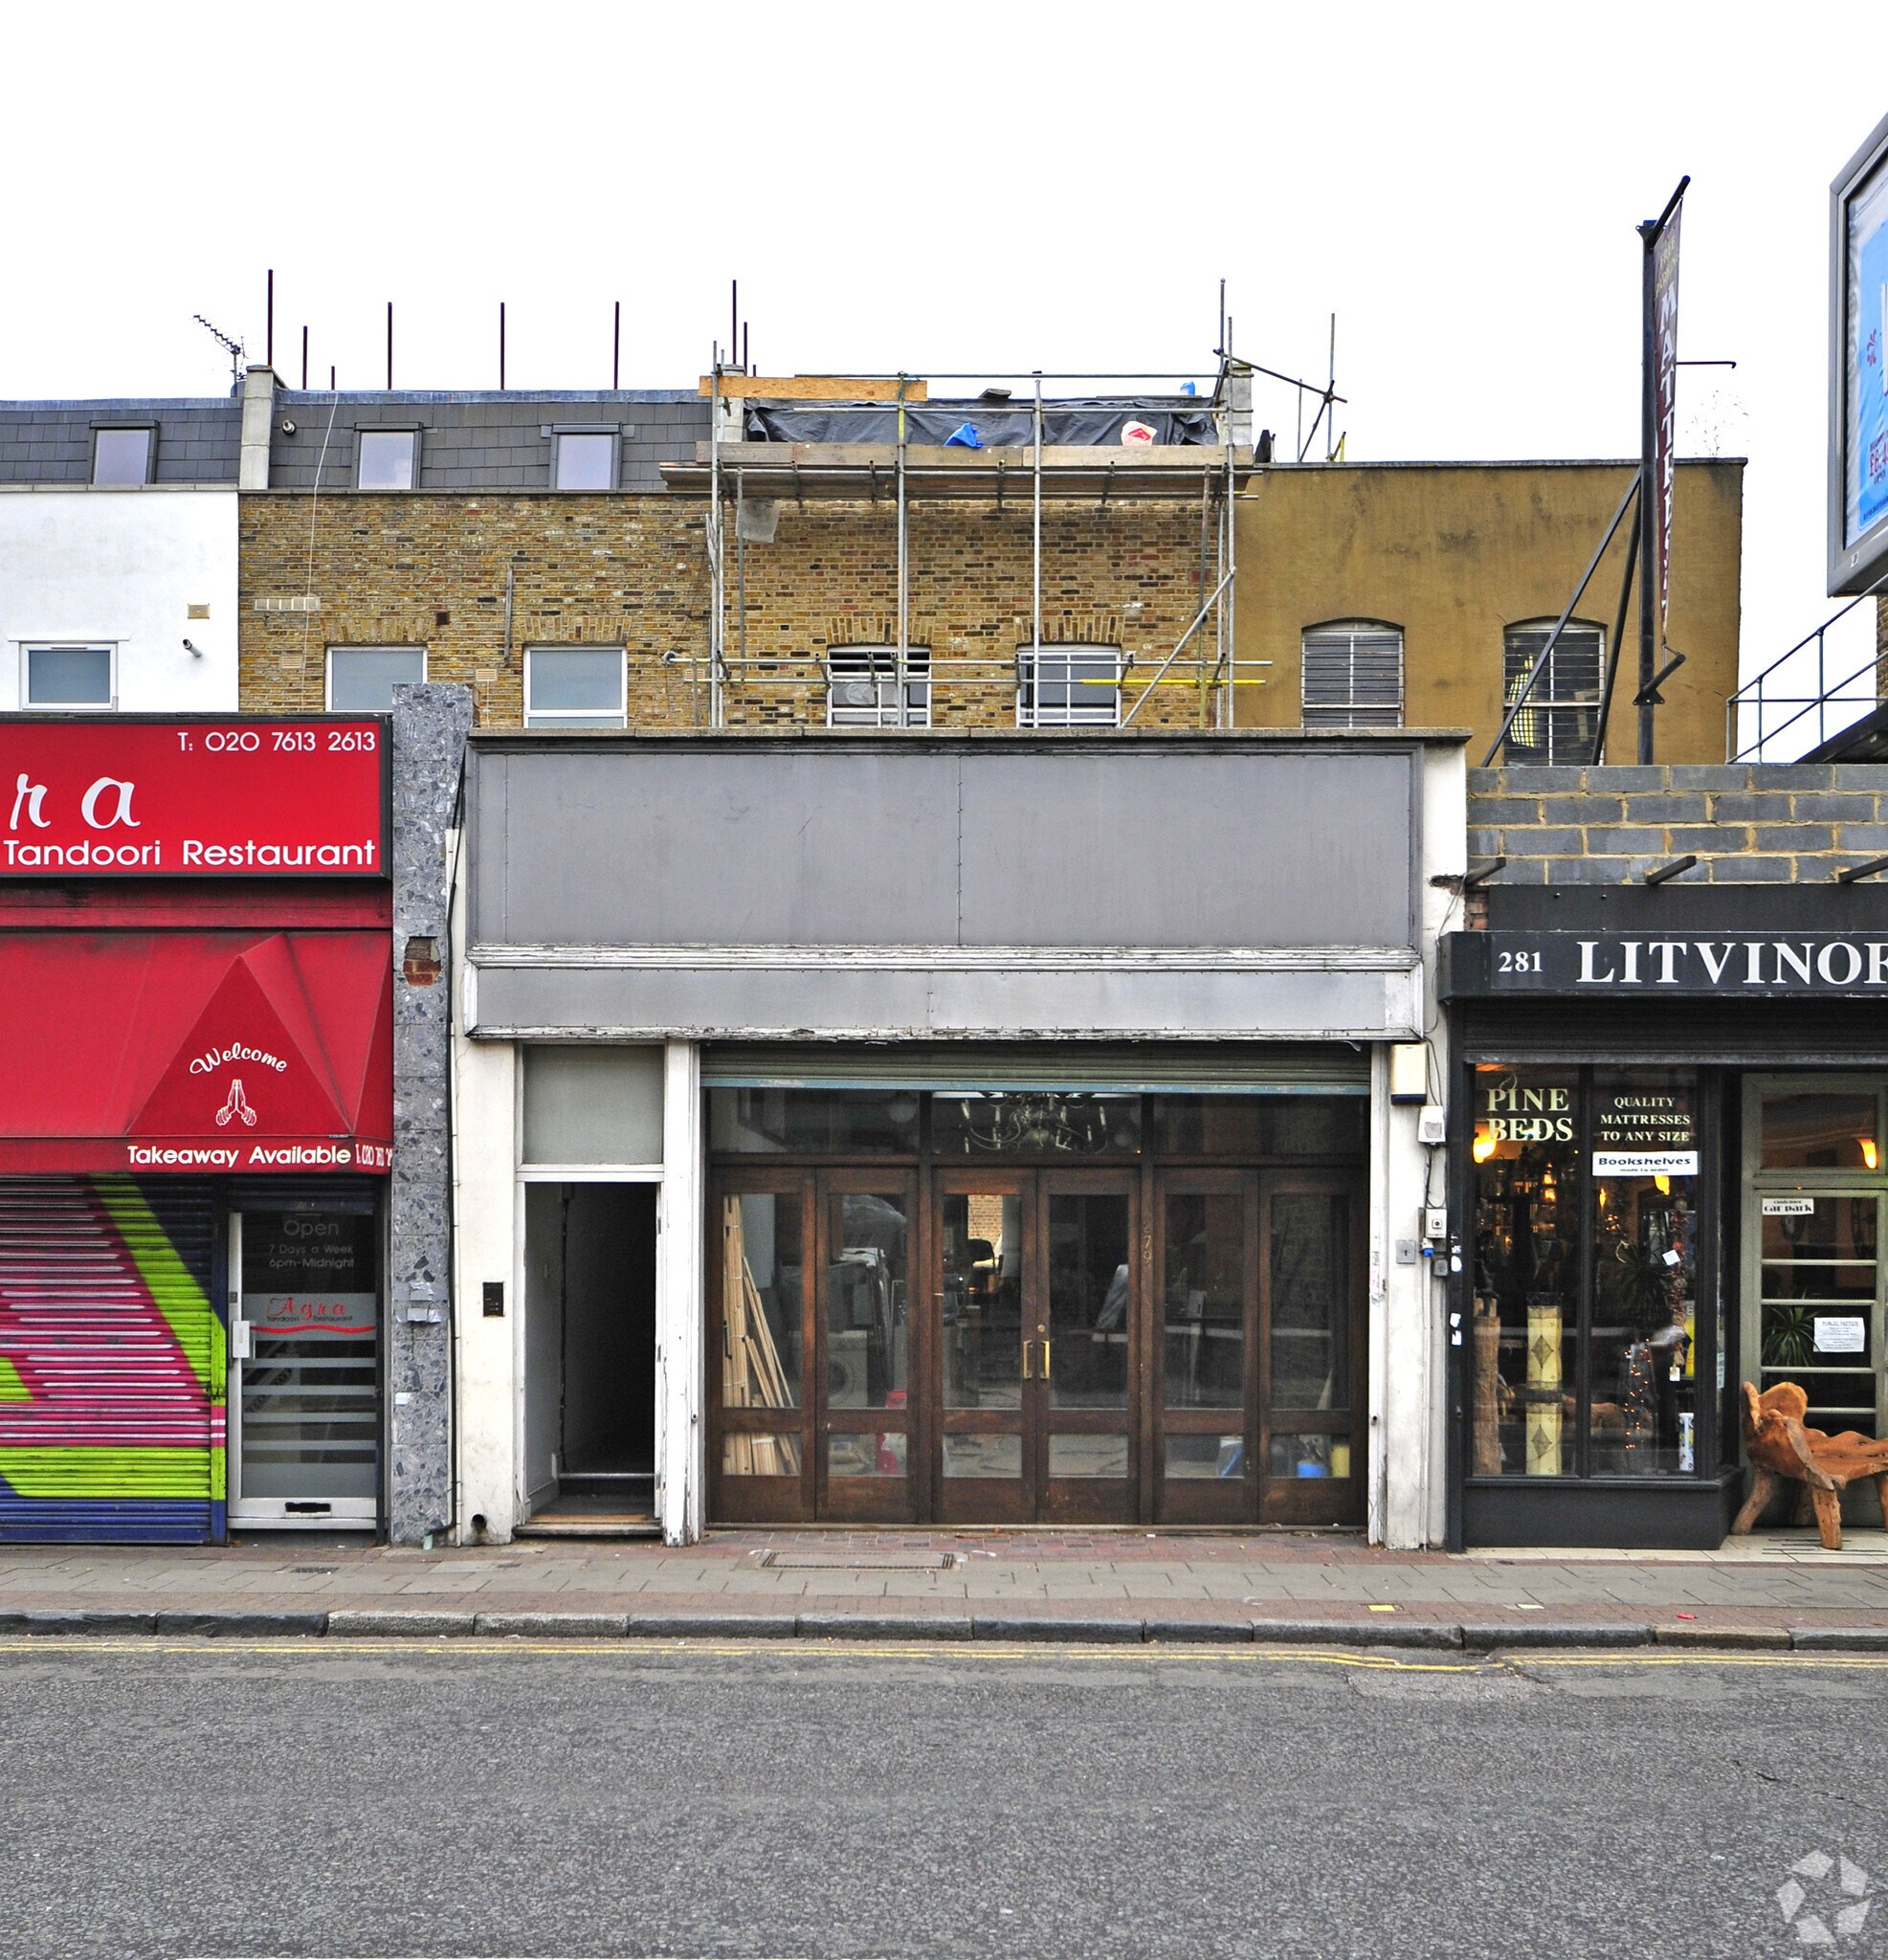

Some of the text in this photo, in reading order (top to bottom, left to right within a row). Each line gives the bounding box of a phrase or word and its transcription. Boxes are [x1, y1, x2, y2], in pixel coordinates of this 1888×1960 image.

[177, 731, 375, 752] T: 020 7613 2613
[3, 839, 375, 865] Tandoori Restaurant
[1498, 950, 1543, 973] 281
[189, 1042, 287, 1075] Welcome
[1486, 1088, 1569, 1112] PINE
[1613, 1097, 1676, 1107] QUALITY
[1486, 1117, 1573, 1142] BEDS
[1600, 1114, 1691, 1125] MATTRESSES
[1601, 1130, 1690, 1142] TO ANY SIZE
[127, 1147, 239, 1167] Takeaway
[248, 1146, 351, 1164] Available
[1598, 1157, 1691, 1166] Bookshelves
[283, 1219, 340, 1239] Open
[269, 1244, 276, 1256] 7
[278, 1244, 306, 1257] Days
[323, 1244, 354, 1255] Week
[269, 1258, 355, 1270] 6pm-Midnight
[267, 1297, 345, 1322] Agra
